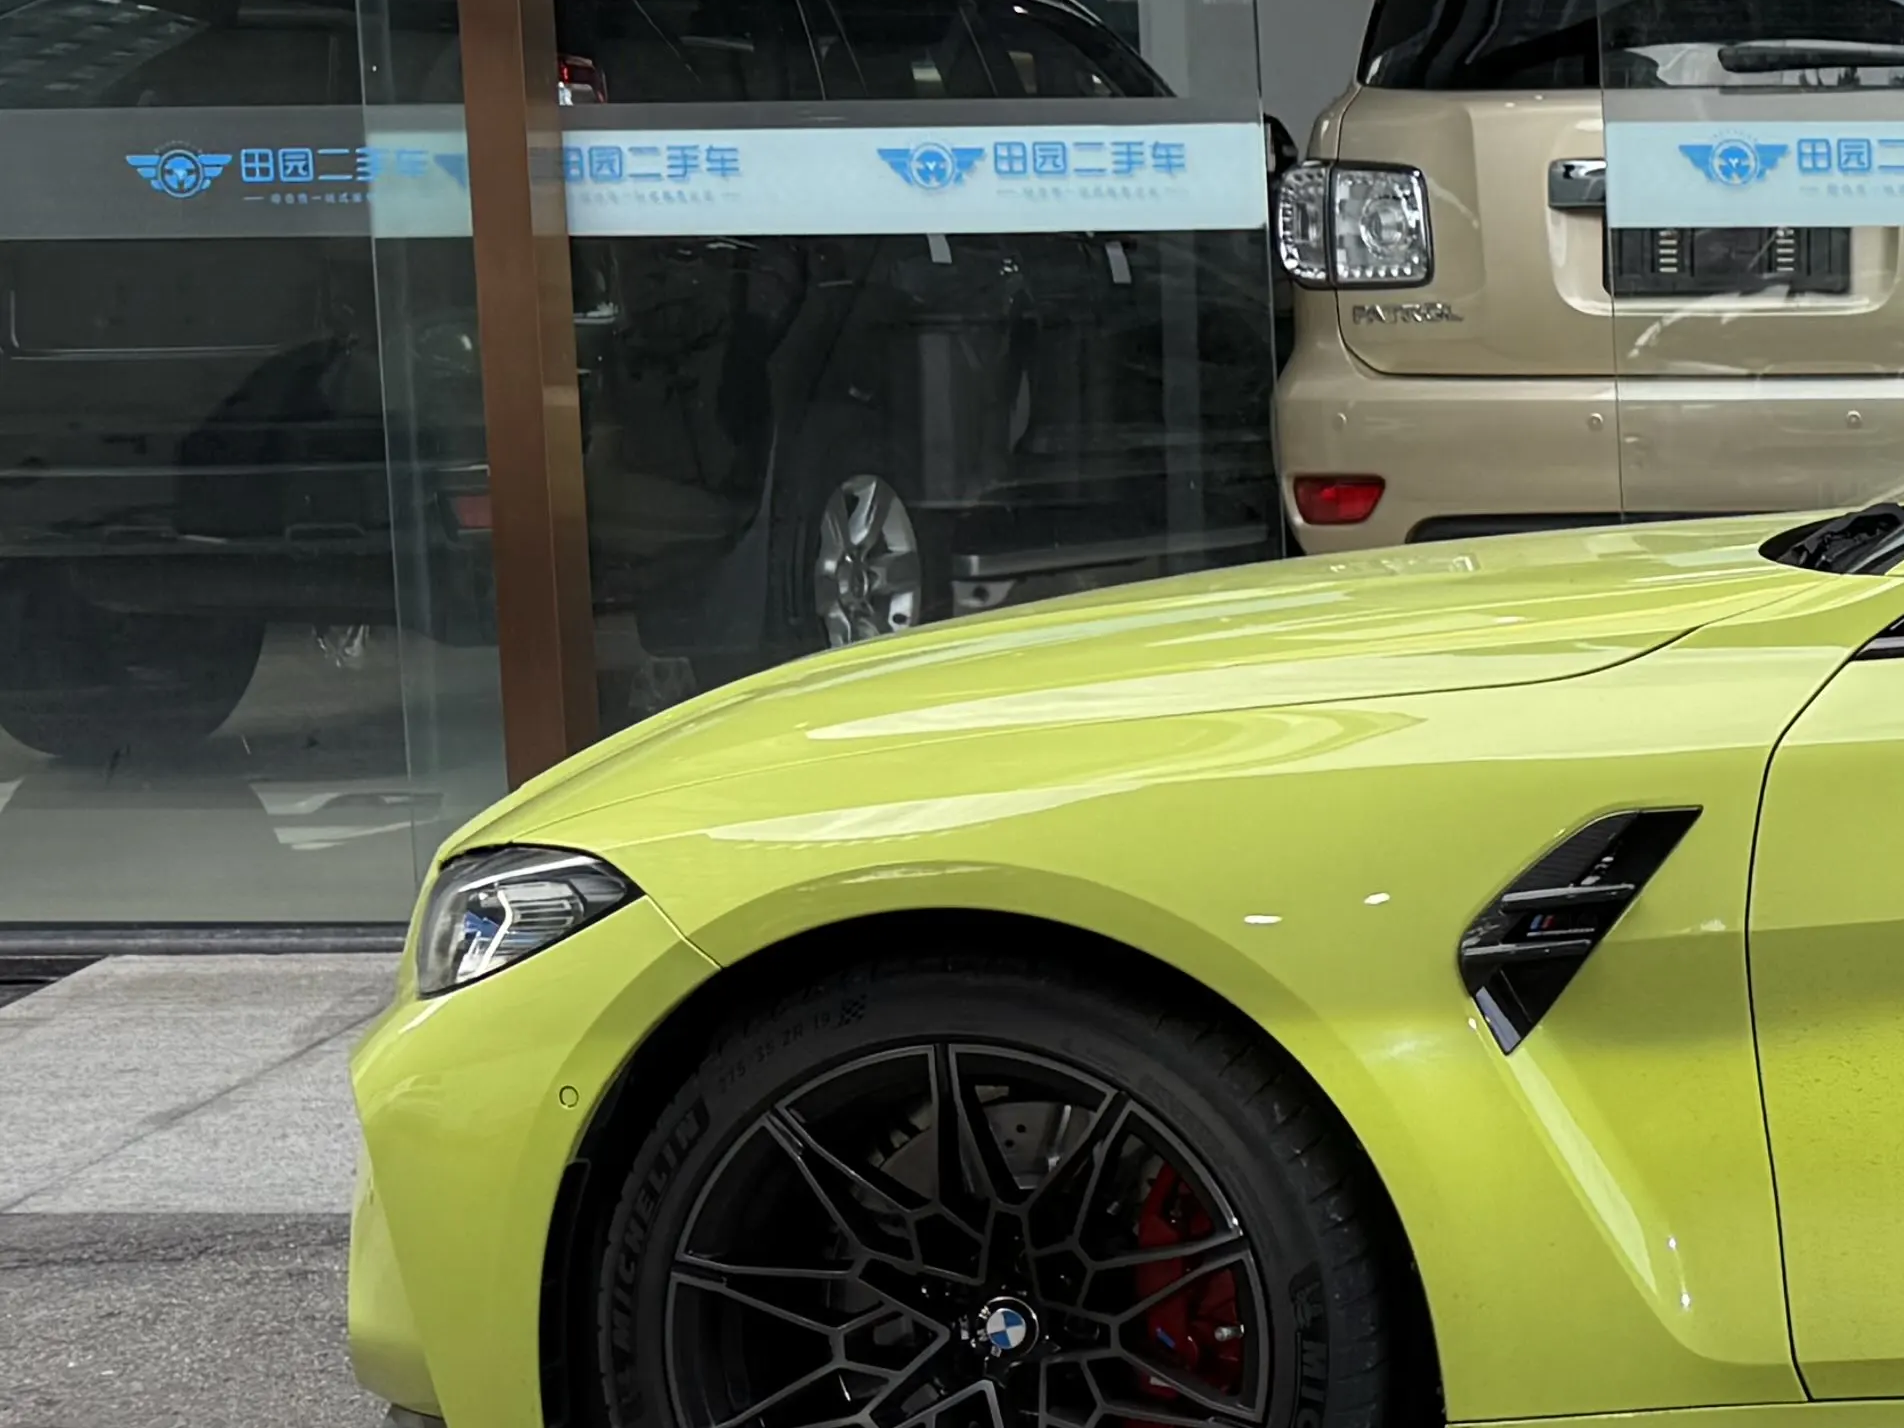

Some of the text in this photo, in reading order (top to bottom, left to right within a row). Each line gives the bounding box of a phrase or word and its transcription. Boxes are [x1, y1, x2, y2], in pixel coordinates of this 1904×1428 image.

[993, 140, 1188, 176] 田园二手车
[611, 1106, 704, 1350] MICHELIN
